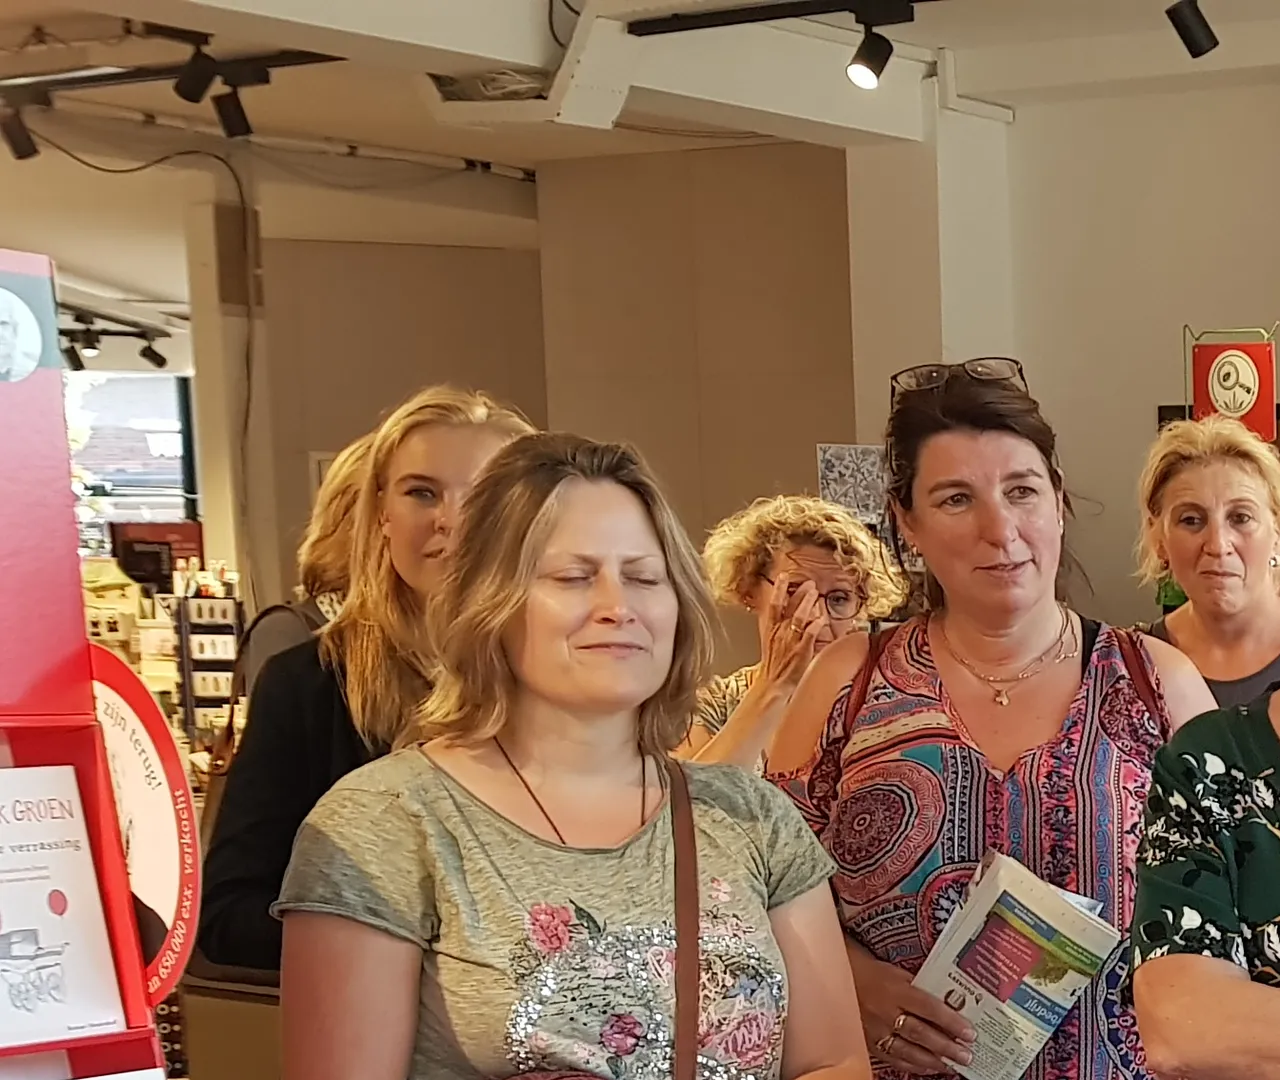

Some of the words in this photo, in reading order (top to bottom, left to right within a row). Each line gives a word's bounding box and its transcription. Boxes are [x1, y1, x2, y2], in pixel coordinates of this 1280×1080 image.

[102, 700, 129, 729] zijn
[129, 727, 164, 792] terug!
[13, 797, 75, 823] GROEN
[173, 788, 196, 876] verkocht
[9, 837, 82, 855] verrassing
